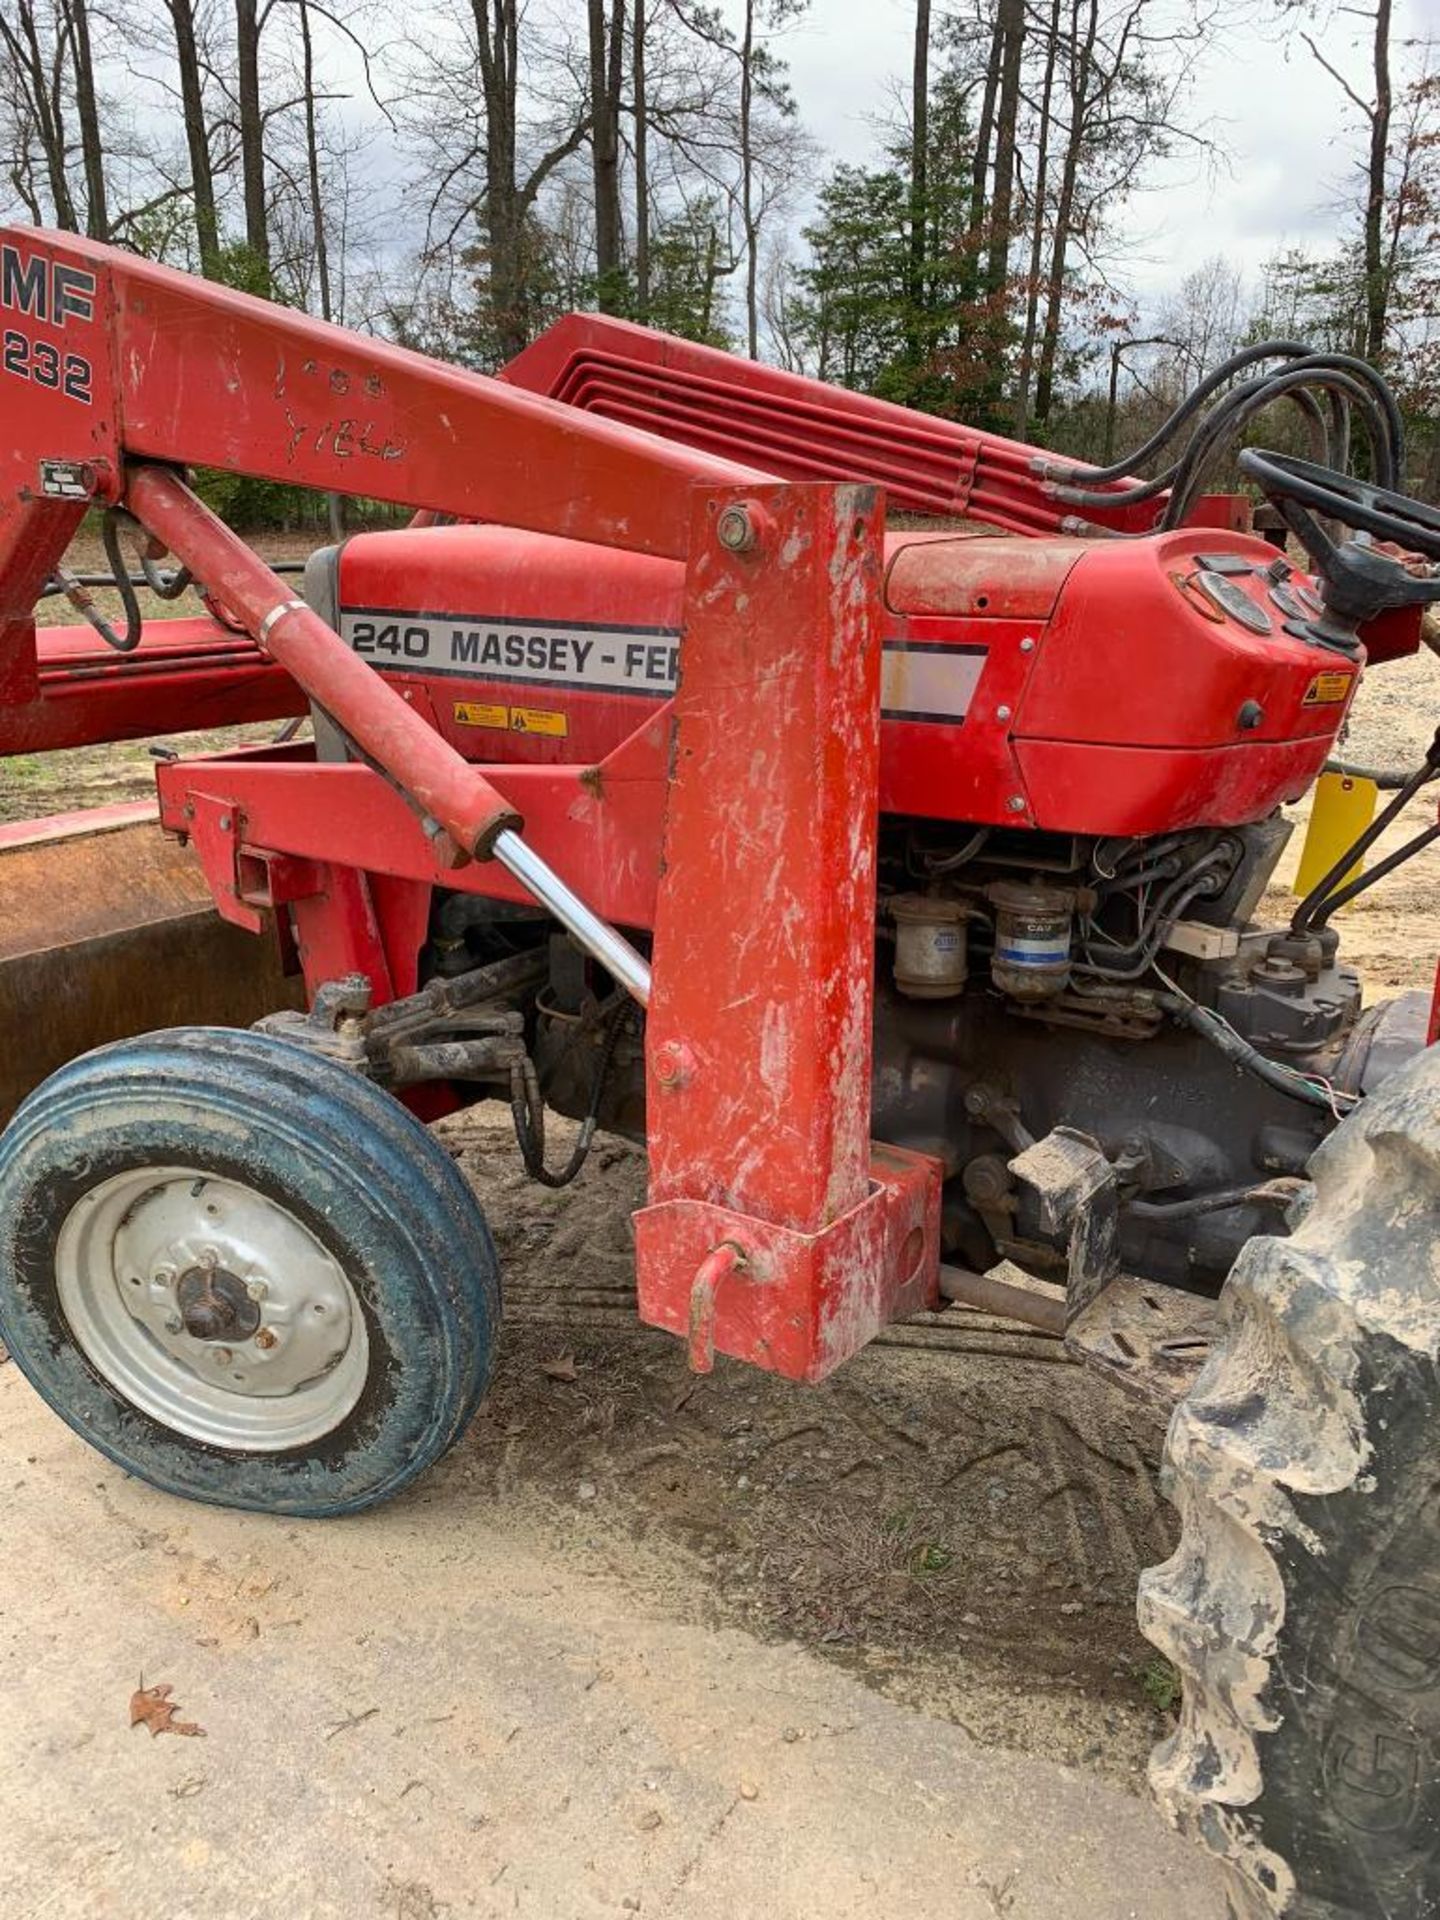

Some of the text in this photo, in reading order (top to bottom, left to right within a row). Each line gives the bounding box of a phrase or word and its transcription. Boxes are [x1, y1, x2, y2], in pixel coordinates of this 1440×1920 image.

[2, 245, 96, 328] MF
[3, 329, 93, 405] 232
[352, 624, 429, 657] 240
[451, 631, 594, 673] MASSEY
